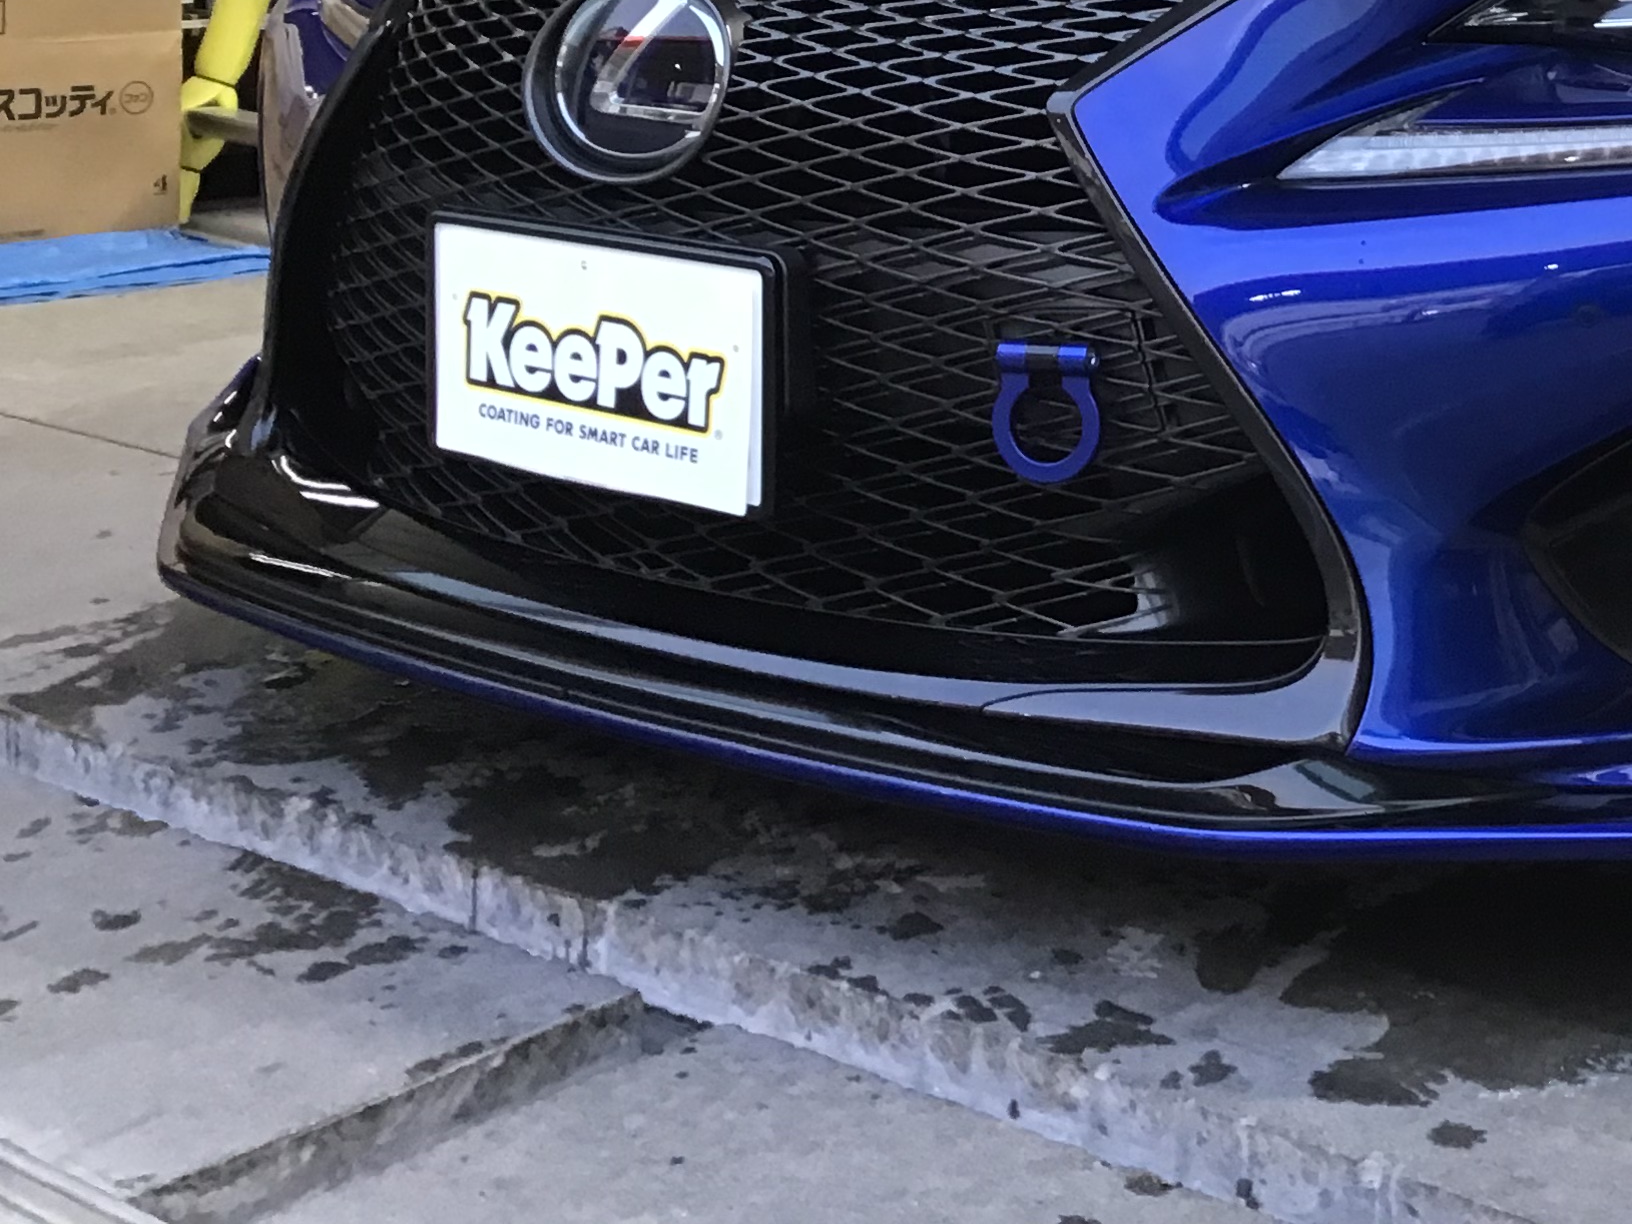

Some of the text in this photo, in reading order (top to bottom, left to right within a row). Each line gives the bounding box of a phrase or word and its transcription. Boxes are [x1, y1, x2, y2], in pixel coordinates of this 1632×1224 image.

[0, 85, 115, 121] スコッティ
[463, 291, 725, 434] KeePer
[478, 403, 699, 464] COATING FOR SMART CAR LIFE
